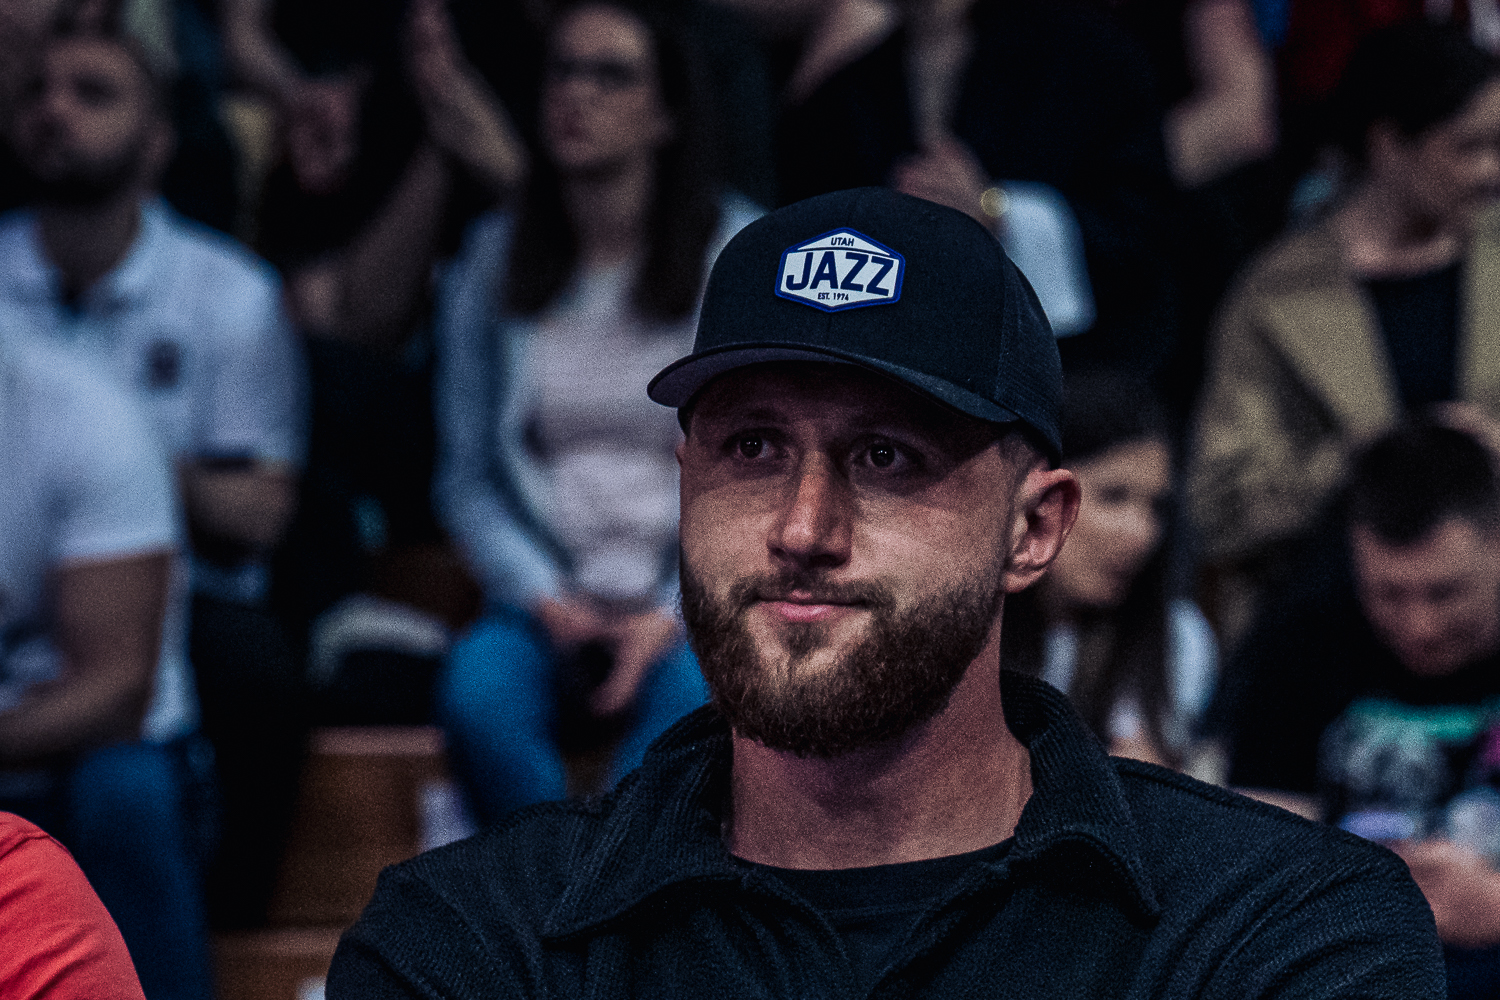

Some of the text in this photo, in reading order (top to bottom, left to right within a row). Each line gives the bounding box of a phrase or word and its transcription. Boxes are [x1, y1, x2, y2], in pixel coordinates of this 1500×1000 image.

[830, 237, 855, 247] UTAH
[785, 251, 894, 297] JAZZ
[833, 292, 849, 301] 1974
